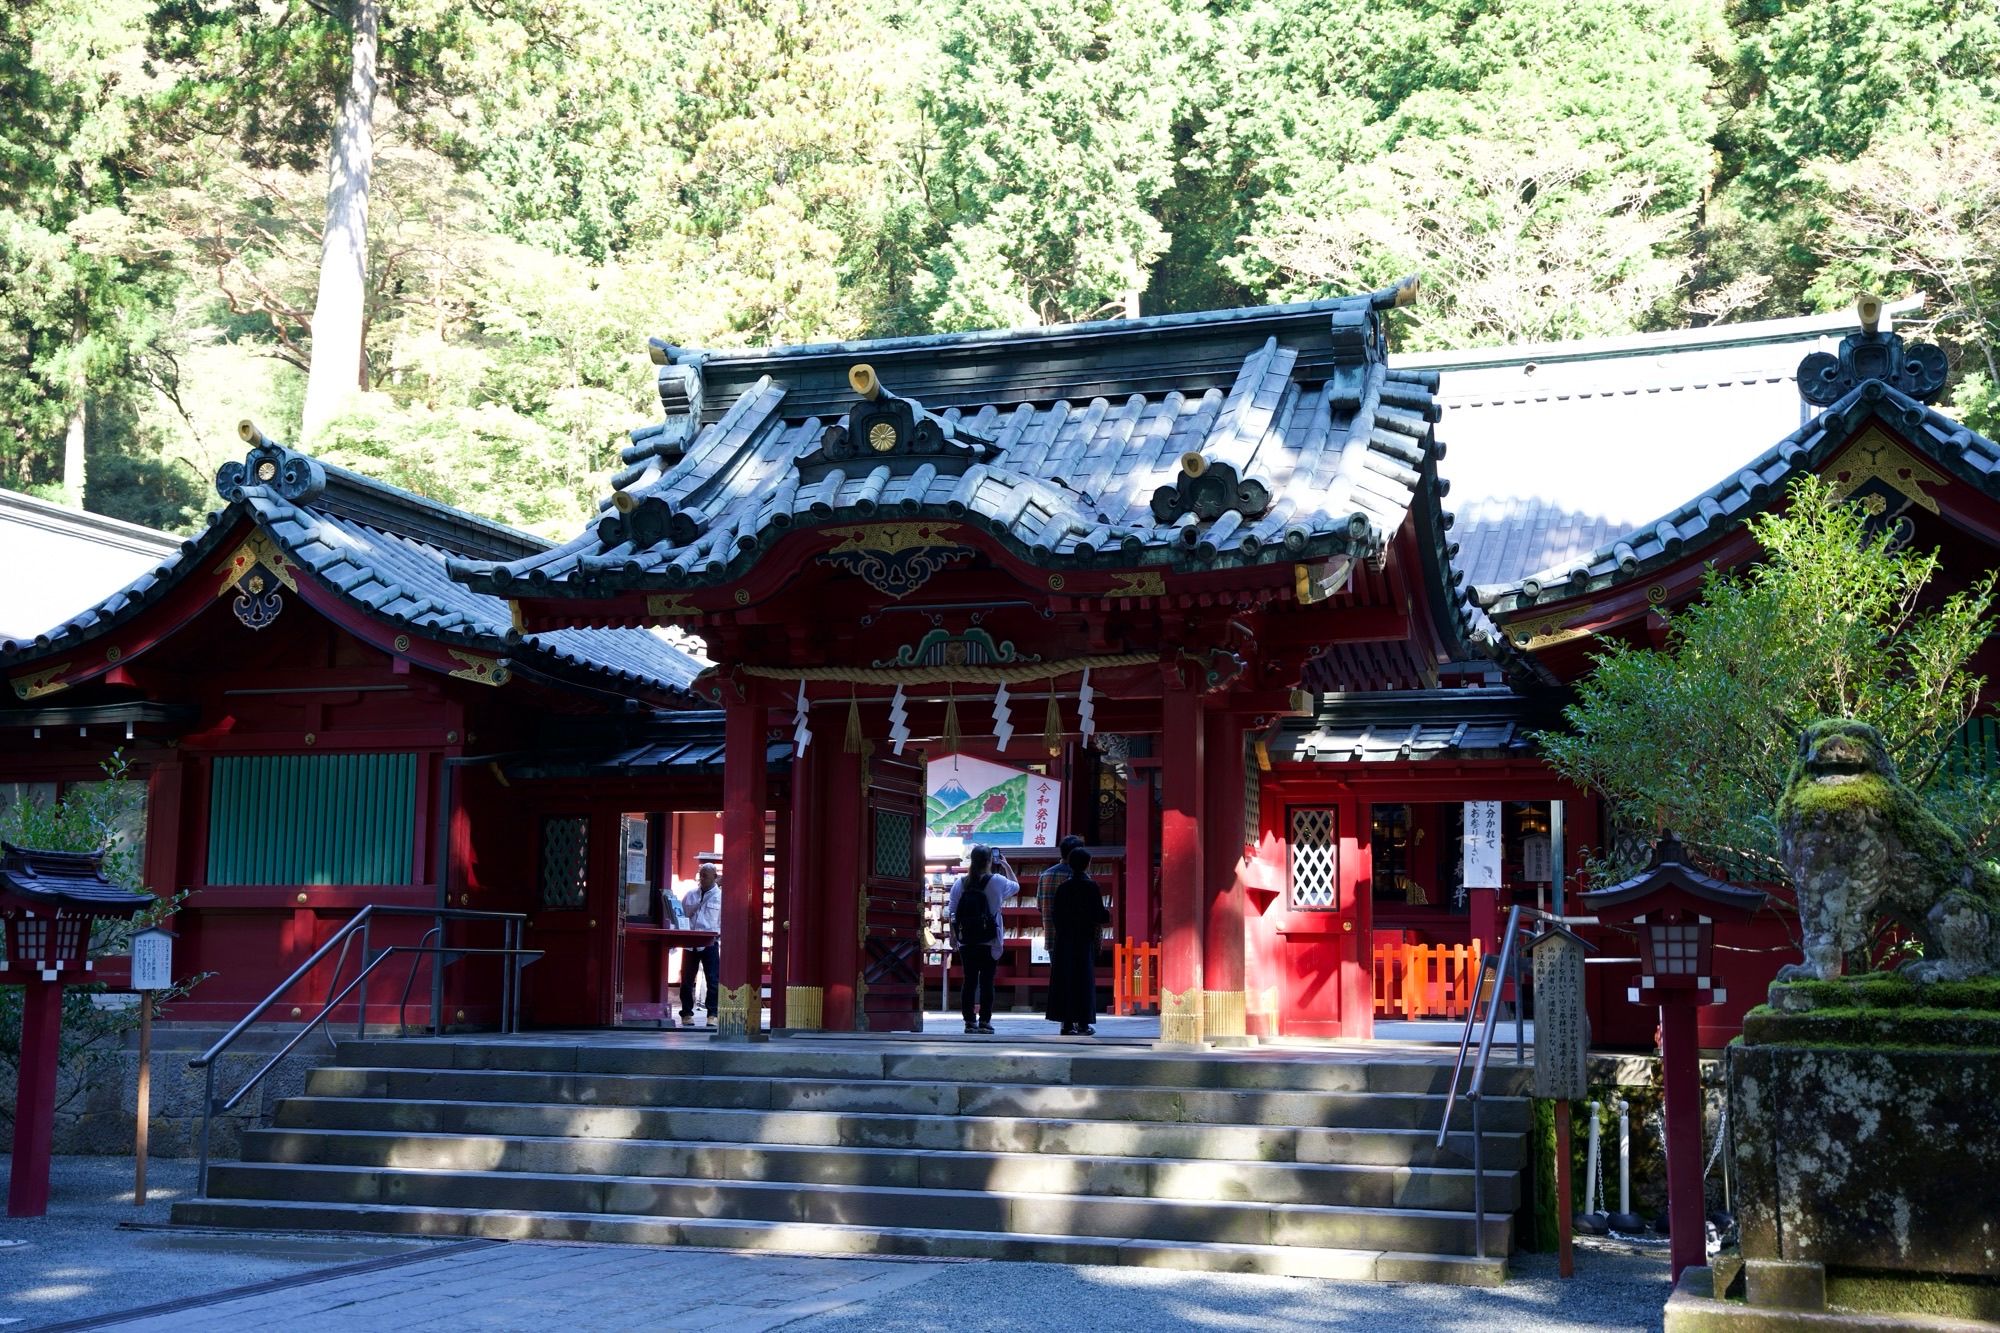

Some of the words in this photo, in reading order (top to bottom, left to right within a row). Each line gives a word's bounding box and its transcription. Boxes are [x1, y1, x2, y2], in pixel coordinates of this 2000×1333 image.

[1034, 782, 1051, 846] 令和癸卯歳
[1485, 801, 1496, 849] に分かれて
